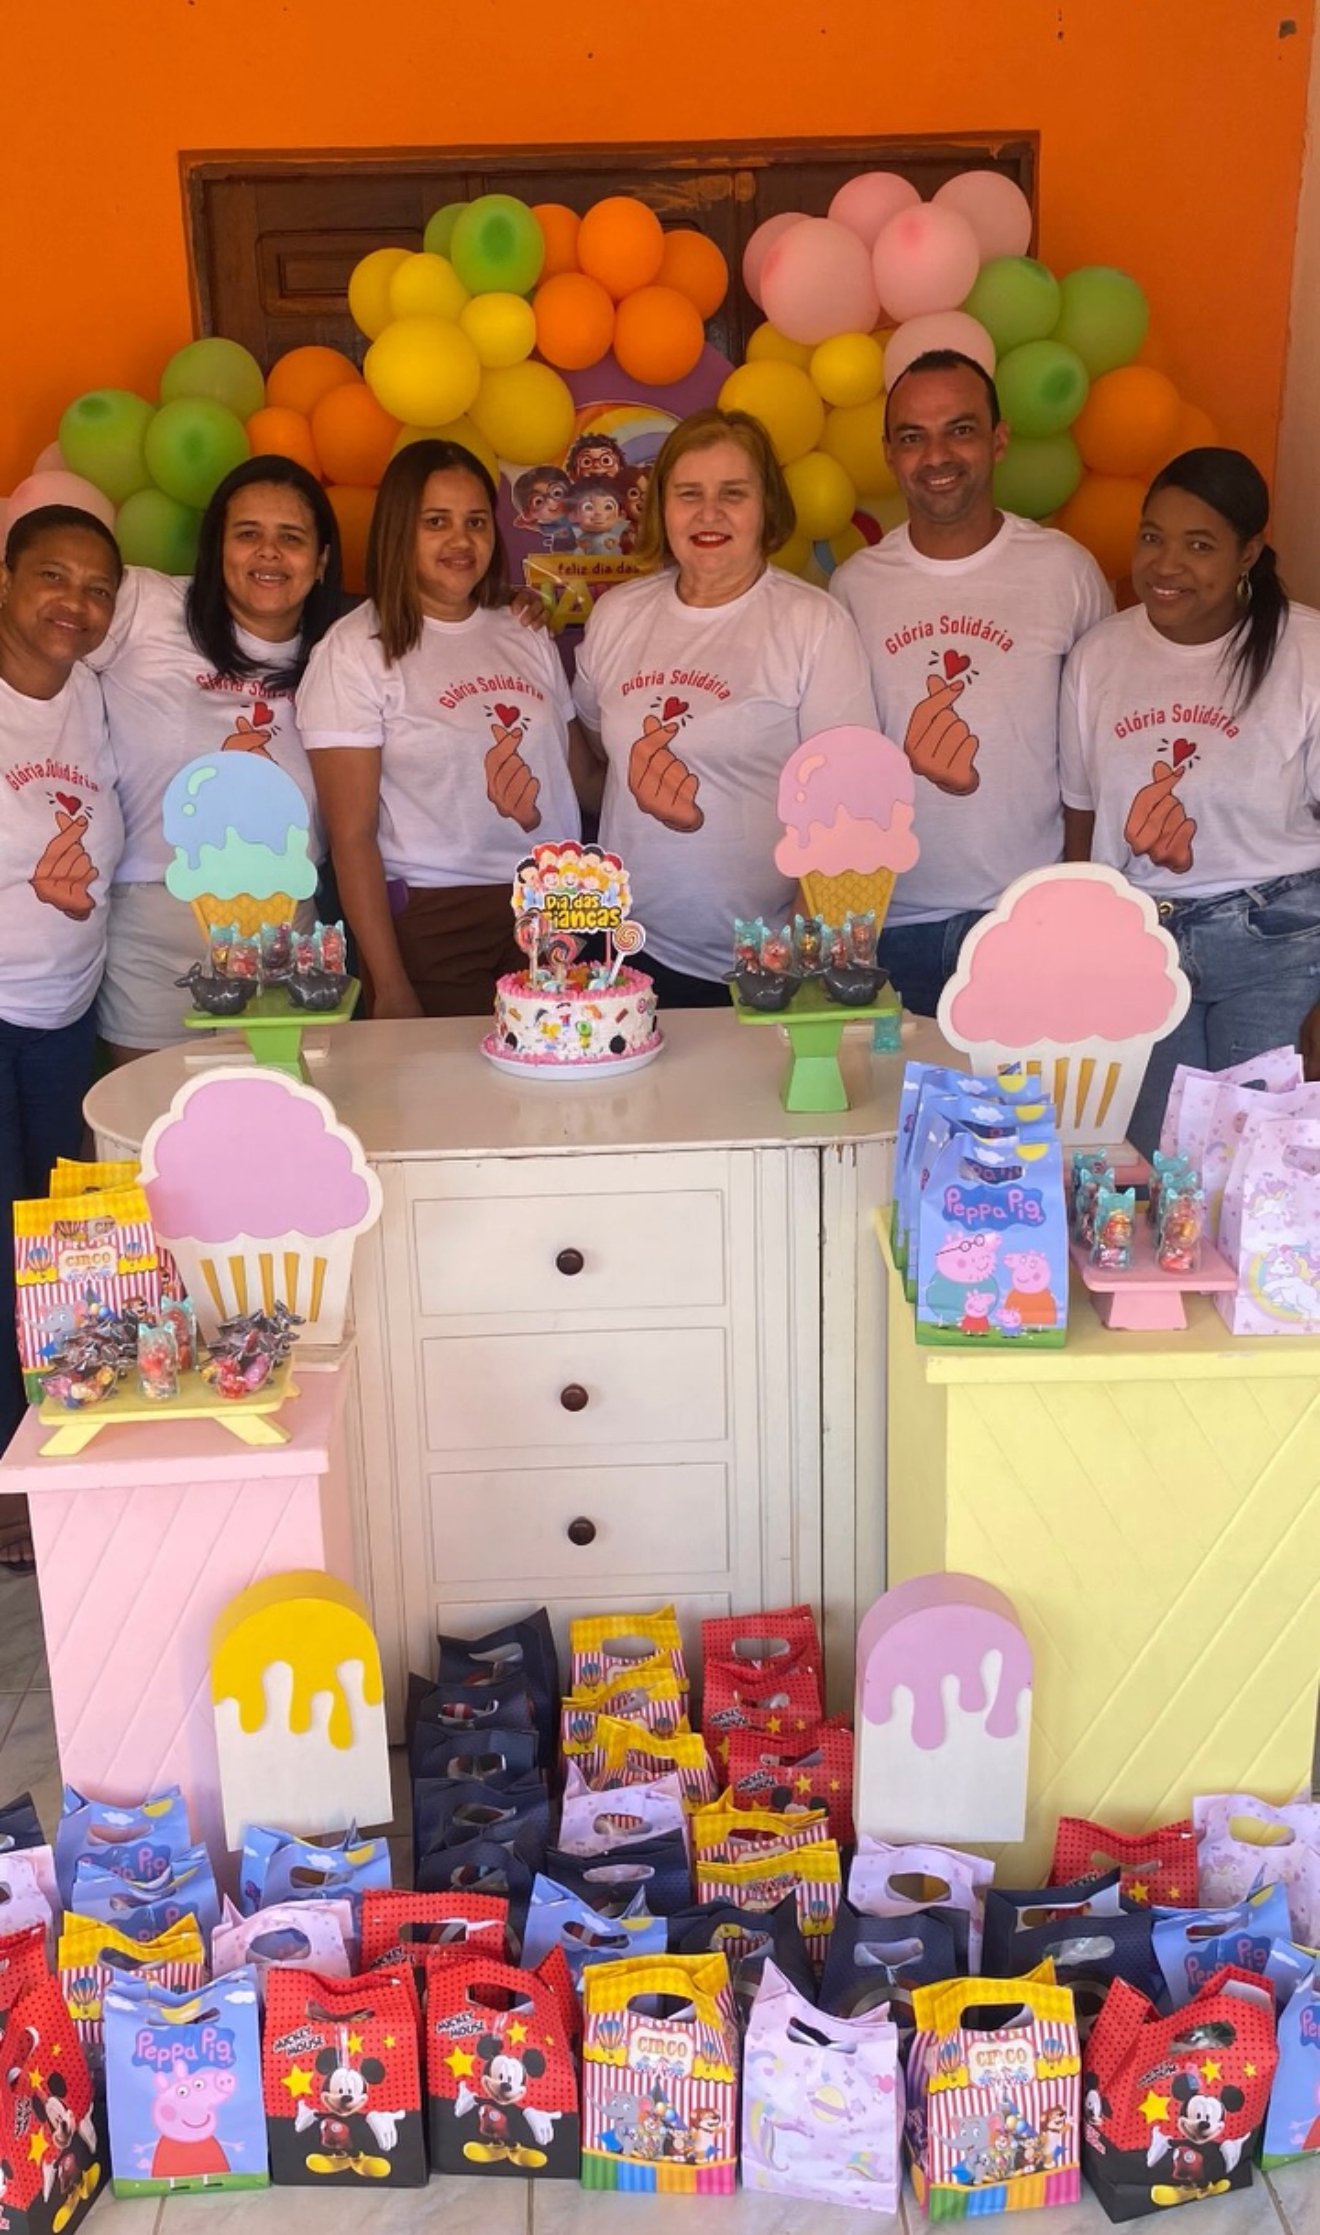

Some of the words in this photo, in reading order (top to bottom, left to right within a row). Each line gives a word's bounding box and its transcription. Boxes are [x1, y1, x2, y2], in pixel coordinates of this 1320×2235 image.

[558, 562, 587, 576] feliz
[592, 561, 613, 575] dia
[884, 621, 934, 655] Glória
[940, 615, 1014, 652] Solidária
[439, 681, 478, 709] Glória
[669, 669, 731, 701] Solidária
[1114, 708, 1166, 739] Glória
[545, 894, 569, 910] Dia
[573, 892, 600, 909] das
[945, 1187, 1007, 1224] Peppa
[1007, 1189, 1044, 1222] Pig
[138, 2030, 199, 2069] Peppa
[202, 2026, 234, 2064] Pig
